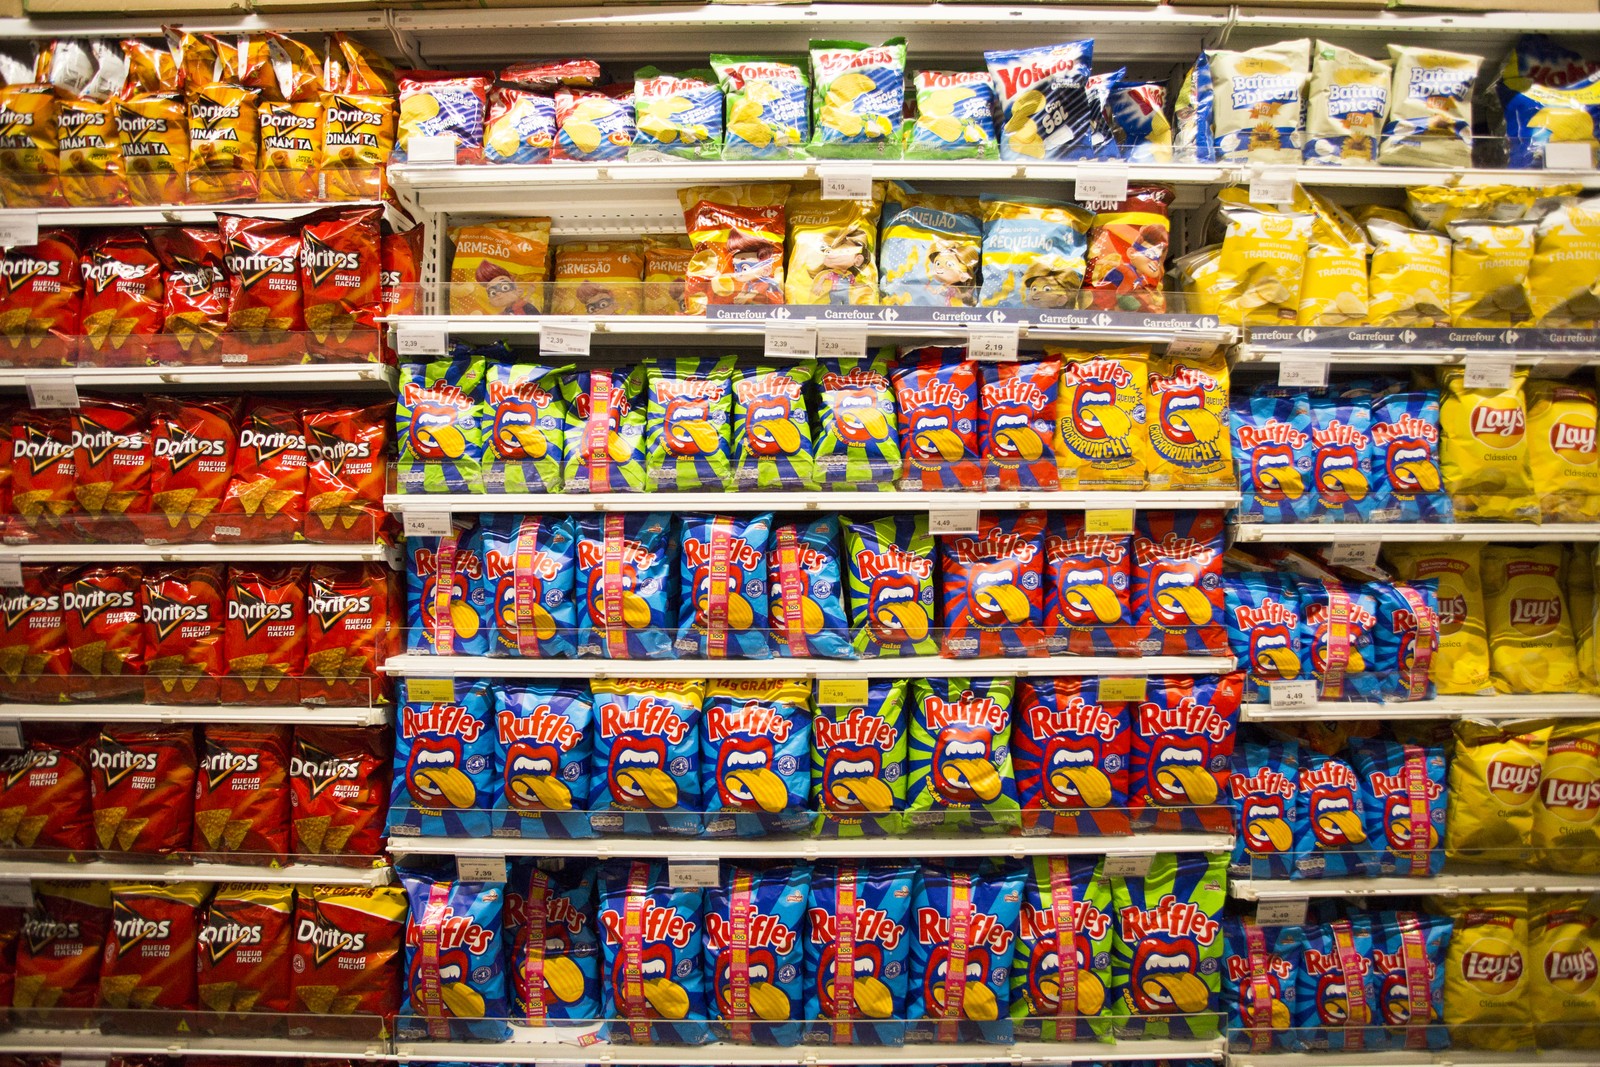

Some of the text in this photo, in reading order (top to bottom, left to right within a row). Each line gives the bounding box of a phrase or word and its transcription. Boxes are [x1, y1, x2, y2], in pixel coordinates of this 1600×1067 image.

[1233, 75, 1299, 92] Batata
[1410, 68, 1476, 87] Batata
[1328, 84, 1388, 103] Batata
[192, 104, 240, 119] Doritos
[261, 114, 316, 130] Doritos
[328, 108, 383, 125] Doritos
[456, 238, 509, 258] ARMESÃO
[990, 236, 1053, 251] REQUEIJÃO
[225, 254, 294, 275] Doritos
[716, 308, 767, 319] Carrefour
[824, 309, 874, 320] Carrefour
[932, 311, 982, 322] Carrefour
[1039, 314, 1088, 325] Carrefour
[1143, 318, 1192, 329] Carrefour
[1251, 331, 1292, 341] arrefour
[1348, 331, 1395, 341] Carrefour
[1448, 332, 1495, 342] Carrefour
[1549, 332, 1597, 343] Carrefour
[822, 367, 891, 394] Ruffles
[1065, 356, 1133, 389] Ruffles
[1148, 364, 1217, 396] Ruffles
[404, 379, 481, 411] Ruffles
[489, 376, 553, 410] Ruffles
[656, 375, 725, 405] Ruffles
[737, 371, 803, 405] Ruffles
[899, 377, 970, 414] Ruffles
[981, 376, 1048, 411] Ruffles
[1371, 413, 1438, 446] Ruffles
[1475, 406, 1524, 437] Lay's
[73, 431, 144, 449] Doritos
[240, 429, 306, 449] Doritos
[1237, 418, 1309, 450] Ruffles
[14, 440, 74, 458] Dorito
[155, 437, 224, 456] Doritos
[308, 443, 369, 463] Doritos
[113, 460, 144, 468] NACHO
[198, 459, 226, 467] QUEIJO
[1484, 453, 1517, 462] Clássica
[198, 465, 226, 473] NACHO
[955, 528, 1038, 565] Ruffles
[1045, 528, 1125, 565] Ruffles
[1133, 532, 1218, 567] Ruffles
[857, 544, 933, 581] Ruffles
[64, 590, 134, 611] Doritos
[228, 600, 292, 620] Doritos
[1512, 596, 1559, 626] Lay's
[345, 617, 372, 625] QUEIJO
[1234, 597, 1298, 632] Ruffles
[267, 624, 295, 632] QUEIJO
[1148, 617, 1188, 635] churrasco
[402, 702, 485, 743] Ruffles
[600, 697, 690, 745] Ruffles
[707, 699, 794, 744] Ruffles
[925, 690, 1011, 734] Ruffles
[1029, 697, 1121, 741] Ruffles
[1139, 696, 1231, 743] Ruffles
[497, 704, 584, 752] Ruffles
[814, 707, 898, 751] Ruffles
[90, 748, 158, 770] Doritos
[290, 757, 361, 778] Doritos
[30, 772, 58, 780] QUEIJO
[30, 778, 57, 786] NACHO
[132, 776, 156, 784] QUEIJO
[1229, 766, 1296, 800] Ruffles
[1299, 760, 1357, 794] Ruffles
[1491, 761, 1541, 795] Lay's
[1120, 894, 1220, 946] Ruffles
[297, 919, 366, 951] Doritos
[141, 944, 170, 952] QUEIJO
[338, 961, 366, 971] NACHO
[339, 956, 367, 964] QUEIJO
[1467, 950, 1521, 984] Lay's
[1550, 947, 1597, 981] Lay's
